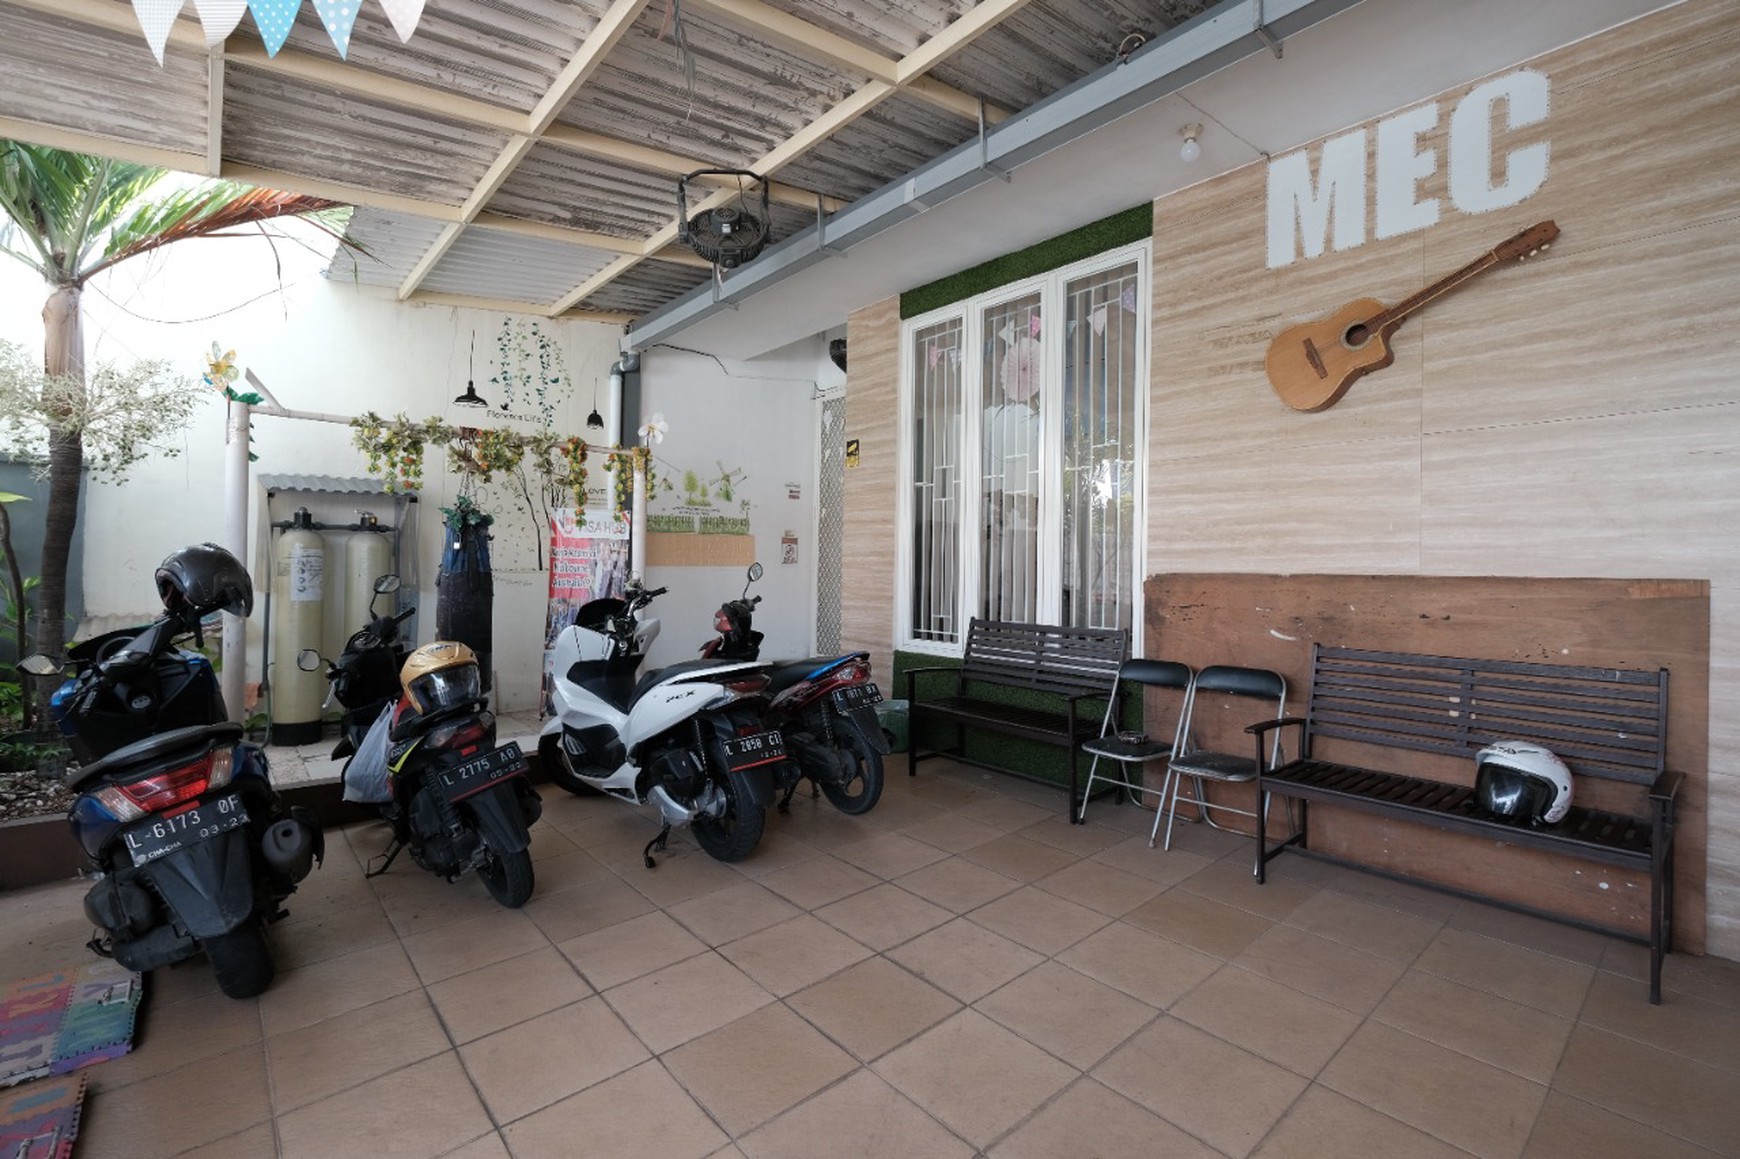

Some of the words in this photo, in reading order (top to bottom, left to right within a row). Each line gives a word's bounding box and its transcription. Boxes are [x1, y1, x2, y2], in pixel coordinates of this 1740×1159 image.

[1266, 67, 1551, 269] MEC
[443, 774, 454, 786] L
[459, 758, 490, 780] 2775
[129, 834, 142, 848] L
[152, 811, 201, 838] 6173
